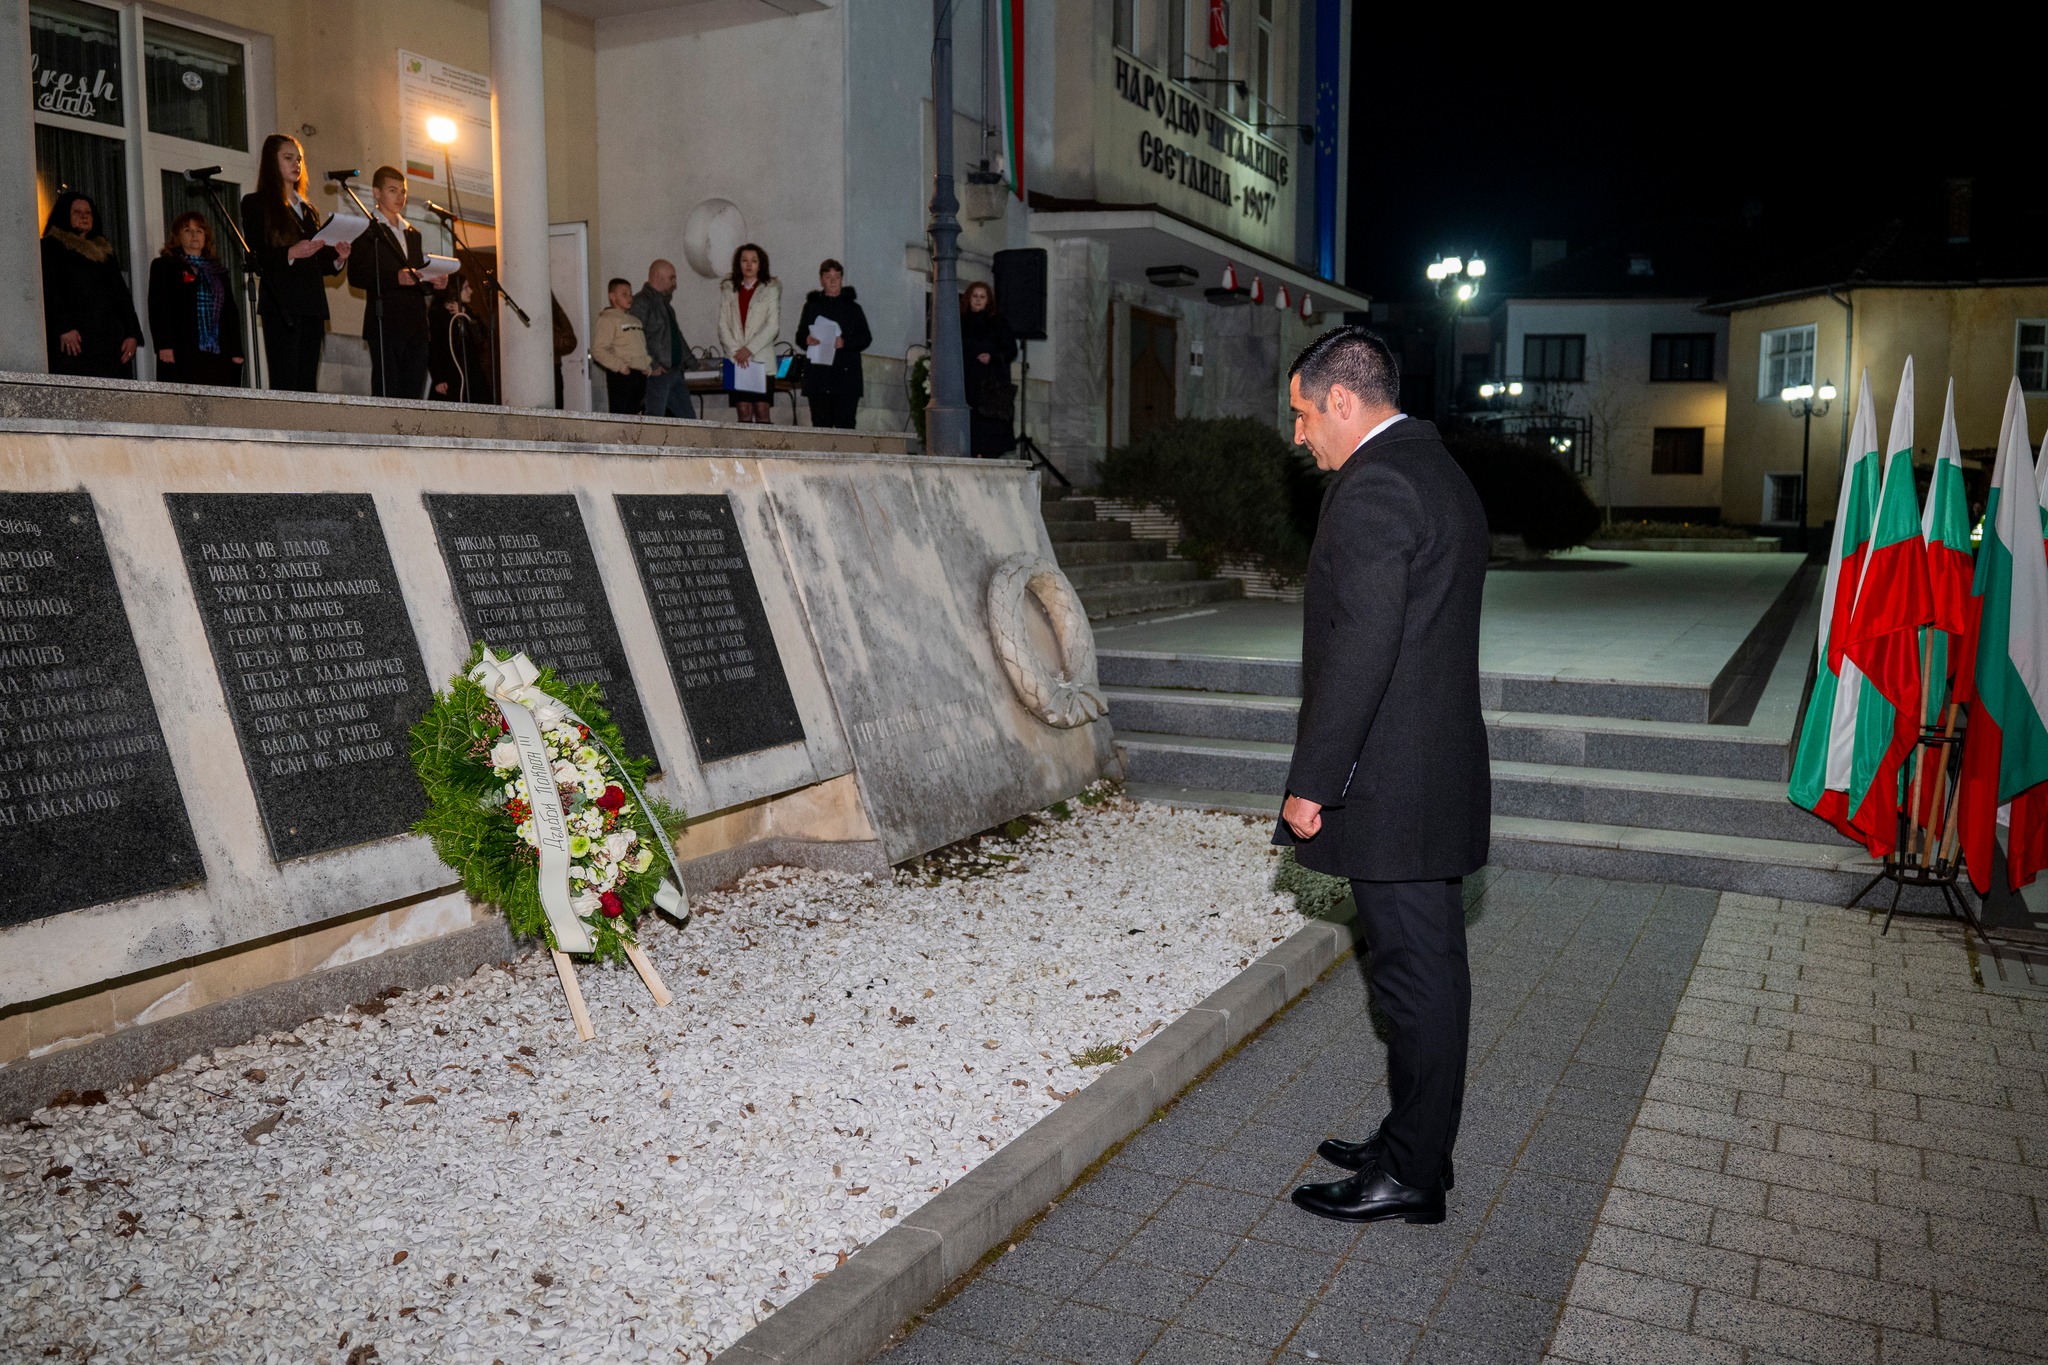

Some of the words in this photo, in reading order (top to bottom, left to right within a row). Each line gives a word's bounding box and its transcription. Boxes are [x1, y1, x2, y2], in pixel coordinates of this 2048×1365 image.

[31, 53, 118, 101] resh
[38, 87, 96, 117] club
[1115, 56, 1200, 138] НАРОДНО
[1204, 108, 1289, 192] ЧИТАЛИЩЕ
[1140, 130, 1233, 207] СВЕТЛИНА
[454, 535, 496, 551] НИКОЛА
[499, 534, 541, 549] ПЕНДЕВ
[638, 531, 664, 543] ВАСИЛ
[201, 543, 251, 560] РАДУЛ
[284, 540, 330, 557] ПАЛОВ
[208, 565, 249, 582] ИВАН
[272, 562, 322, 579] ЗЛАТЕВ
[649, 560, 691, 575] МОХАРЕМ
[708, 557, 744, 570] ОСМАНОВ
[466, 571, 499, 587] МУСА
[653, 576, 681, 591] ЮСУФ
[215, 584, 272, 602] ХРИСТО
[291, 579, 381, 598] ШАЛАМАНОВ
[471, 589, 513, 605] НИКОЛА
[516, 585, 565, 601] ГЕОРГИЕВ
[658, 593, 689, 607] ГЕОРГИ
[223, 606, 268, 624] АНГЕЛ
[290, 601, 344, 619] МАНЧЕВ
[477, 607, 518, 624] ГЕОРГИ
[228, 626, 283, 646] ГЕОРГИ
[483, 625, 524, 642] ХРИСТО
[543, 619, 586, 635] БАКАЛОВ
[235, 650, 283, 669] ПЕТЪР
[562, 652, 602, 669] ПЕНДЕВ
[242, 670, 290, 691] ПЕТЪР
[314, 657, 405, 682] ХАДЖИЯНЧЕВ
[684, 672, 710, 688] КРУМ
[248, 691, 303, 712] НИКОЛА
[254, 714, 291, 733] СПАС
[315, 703, 369, 725] БУЧКОВ
[261, 736, 309, 756] ВАСИЛ
[338, 722, 381, 743] ГУРЕВ
[270, 755, 308, 776] АСАН
[338, 741, 394, 765] МУСКОВ
[26, 789, 121, 822] ДАСКАЛОВ
